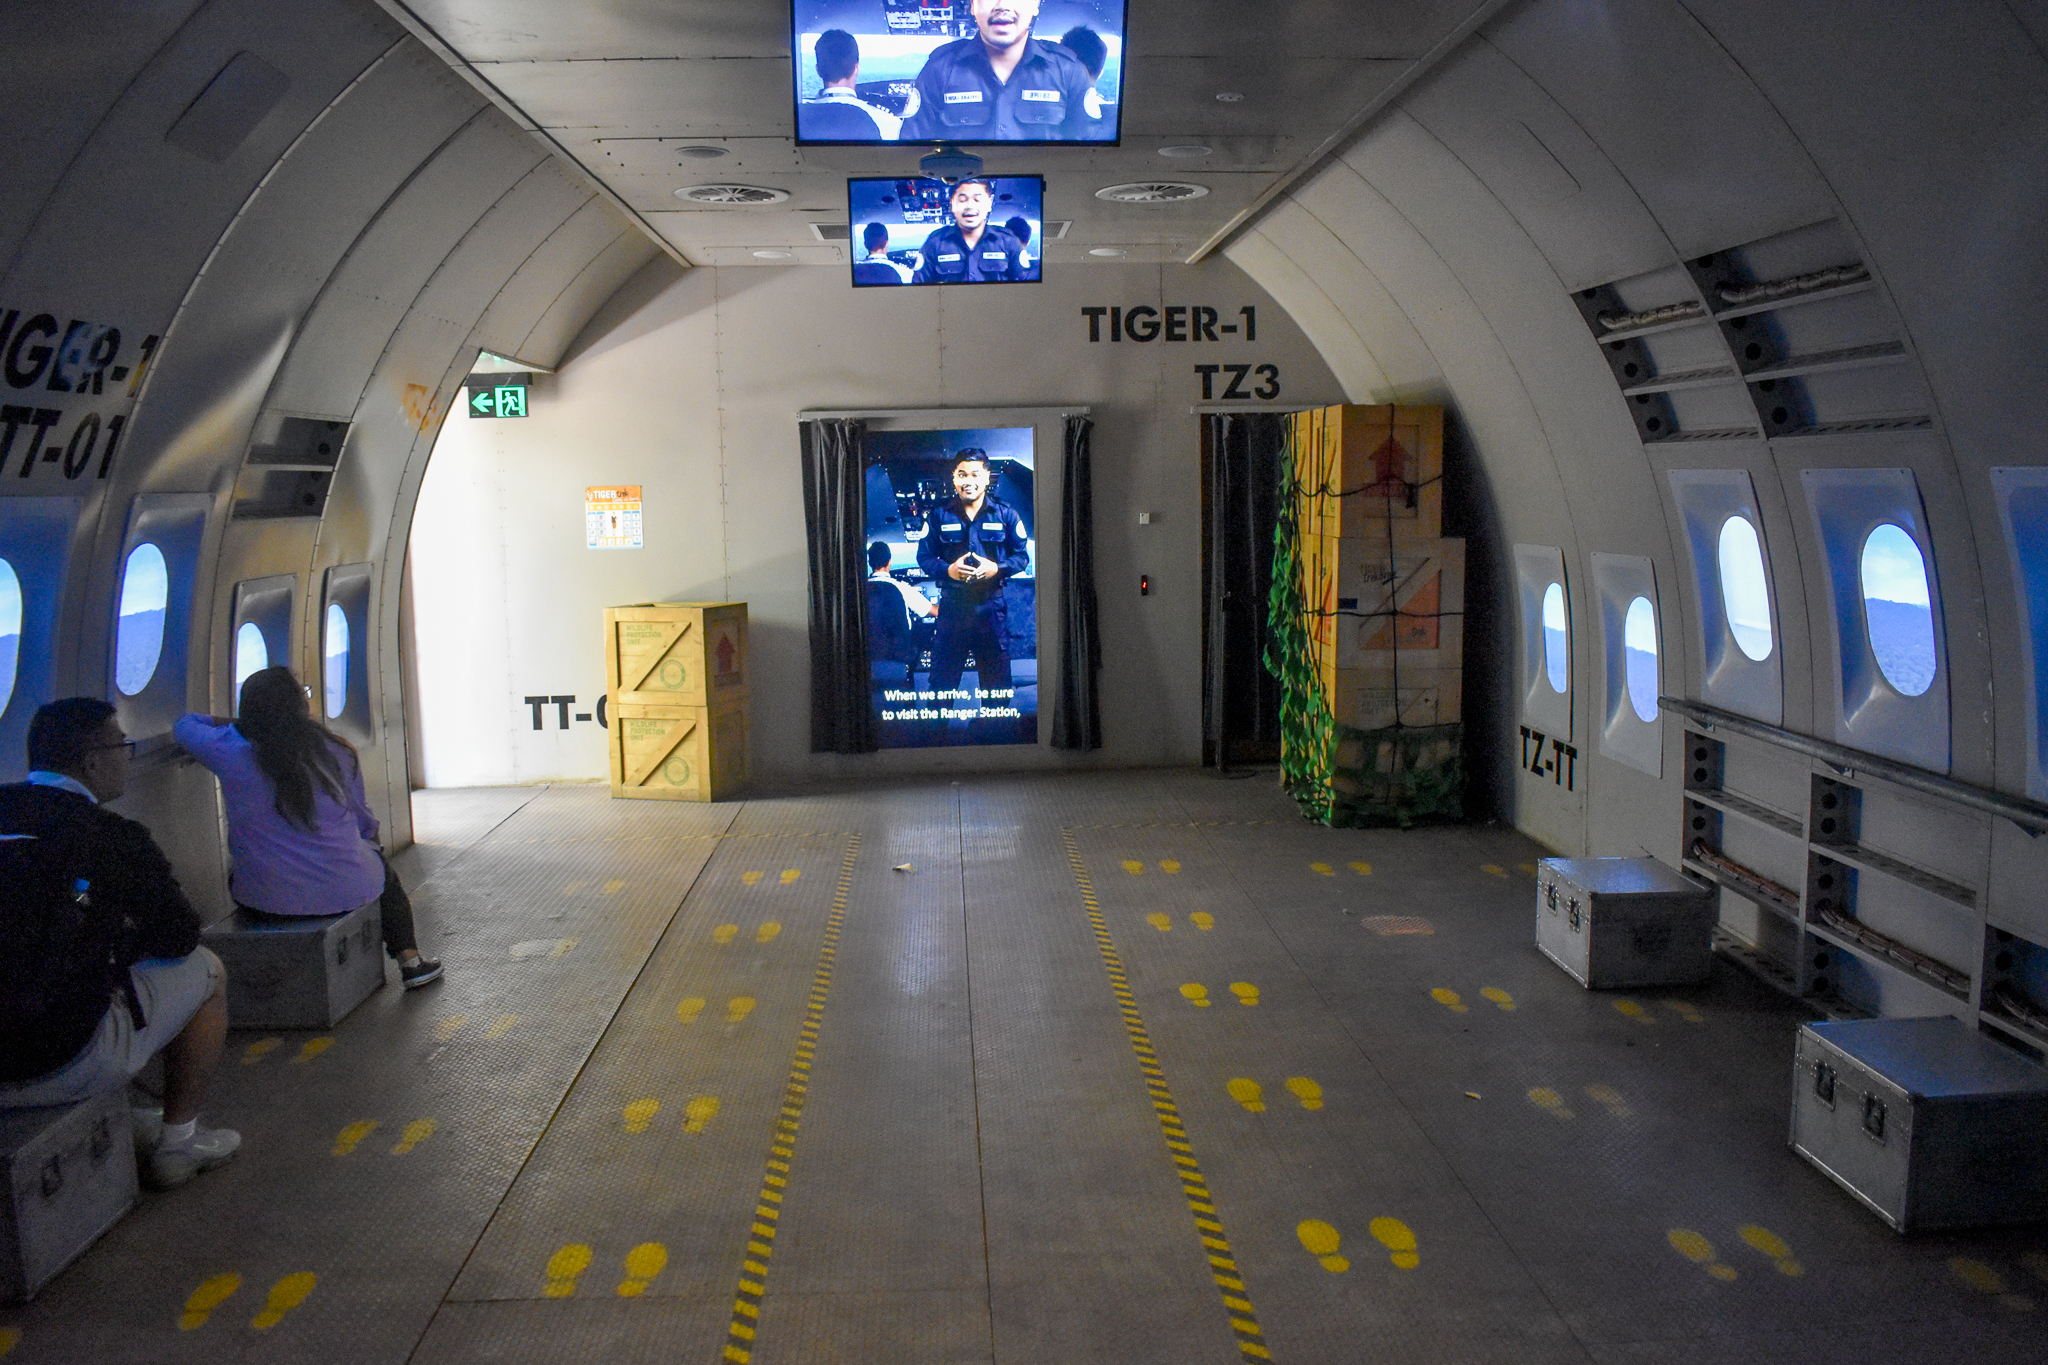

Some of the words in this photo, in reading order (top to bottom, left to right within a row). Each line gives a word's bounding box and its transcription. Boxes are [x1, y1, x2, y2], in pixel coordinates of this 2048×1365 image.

[1081, 305, 1256, 342] TIGER-1
[0, 309, 159, 397] IGER-1
[1194, 363, 1281, 400] TZ3
[593, 490, 616, 499] TIGER
[882, 709, 894, 720] to
[896, 708, 918, 720] visit
[920, 708, 938, 719] the
[940, 707, 978, 720] Ranger
[980, 706, 1021, 719] Station,
[884, 689, 916, 701] When
[919, 691, 935, 700] we
[937, 689, 971, 700] arrive,
[975, 688, 989, 698] be
[991, 688, 1014, 698] sure
[1520, 725, 1578, 791] TZ-TT
